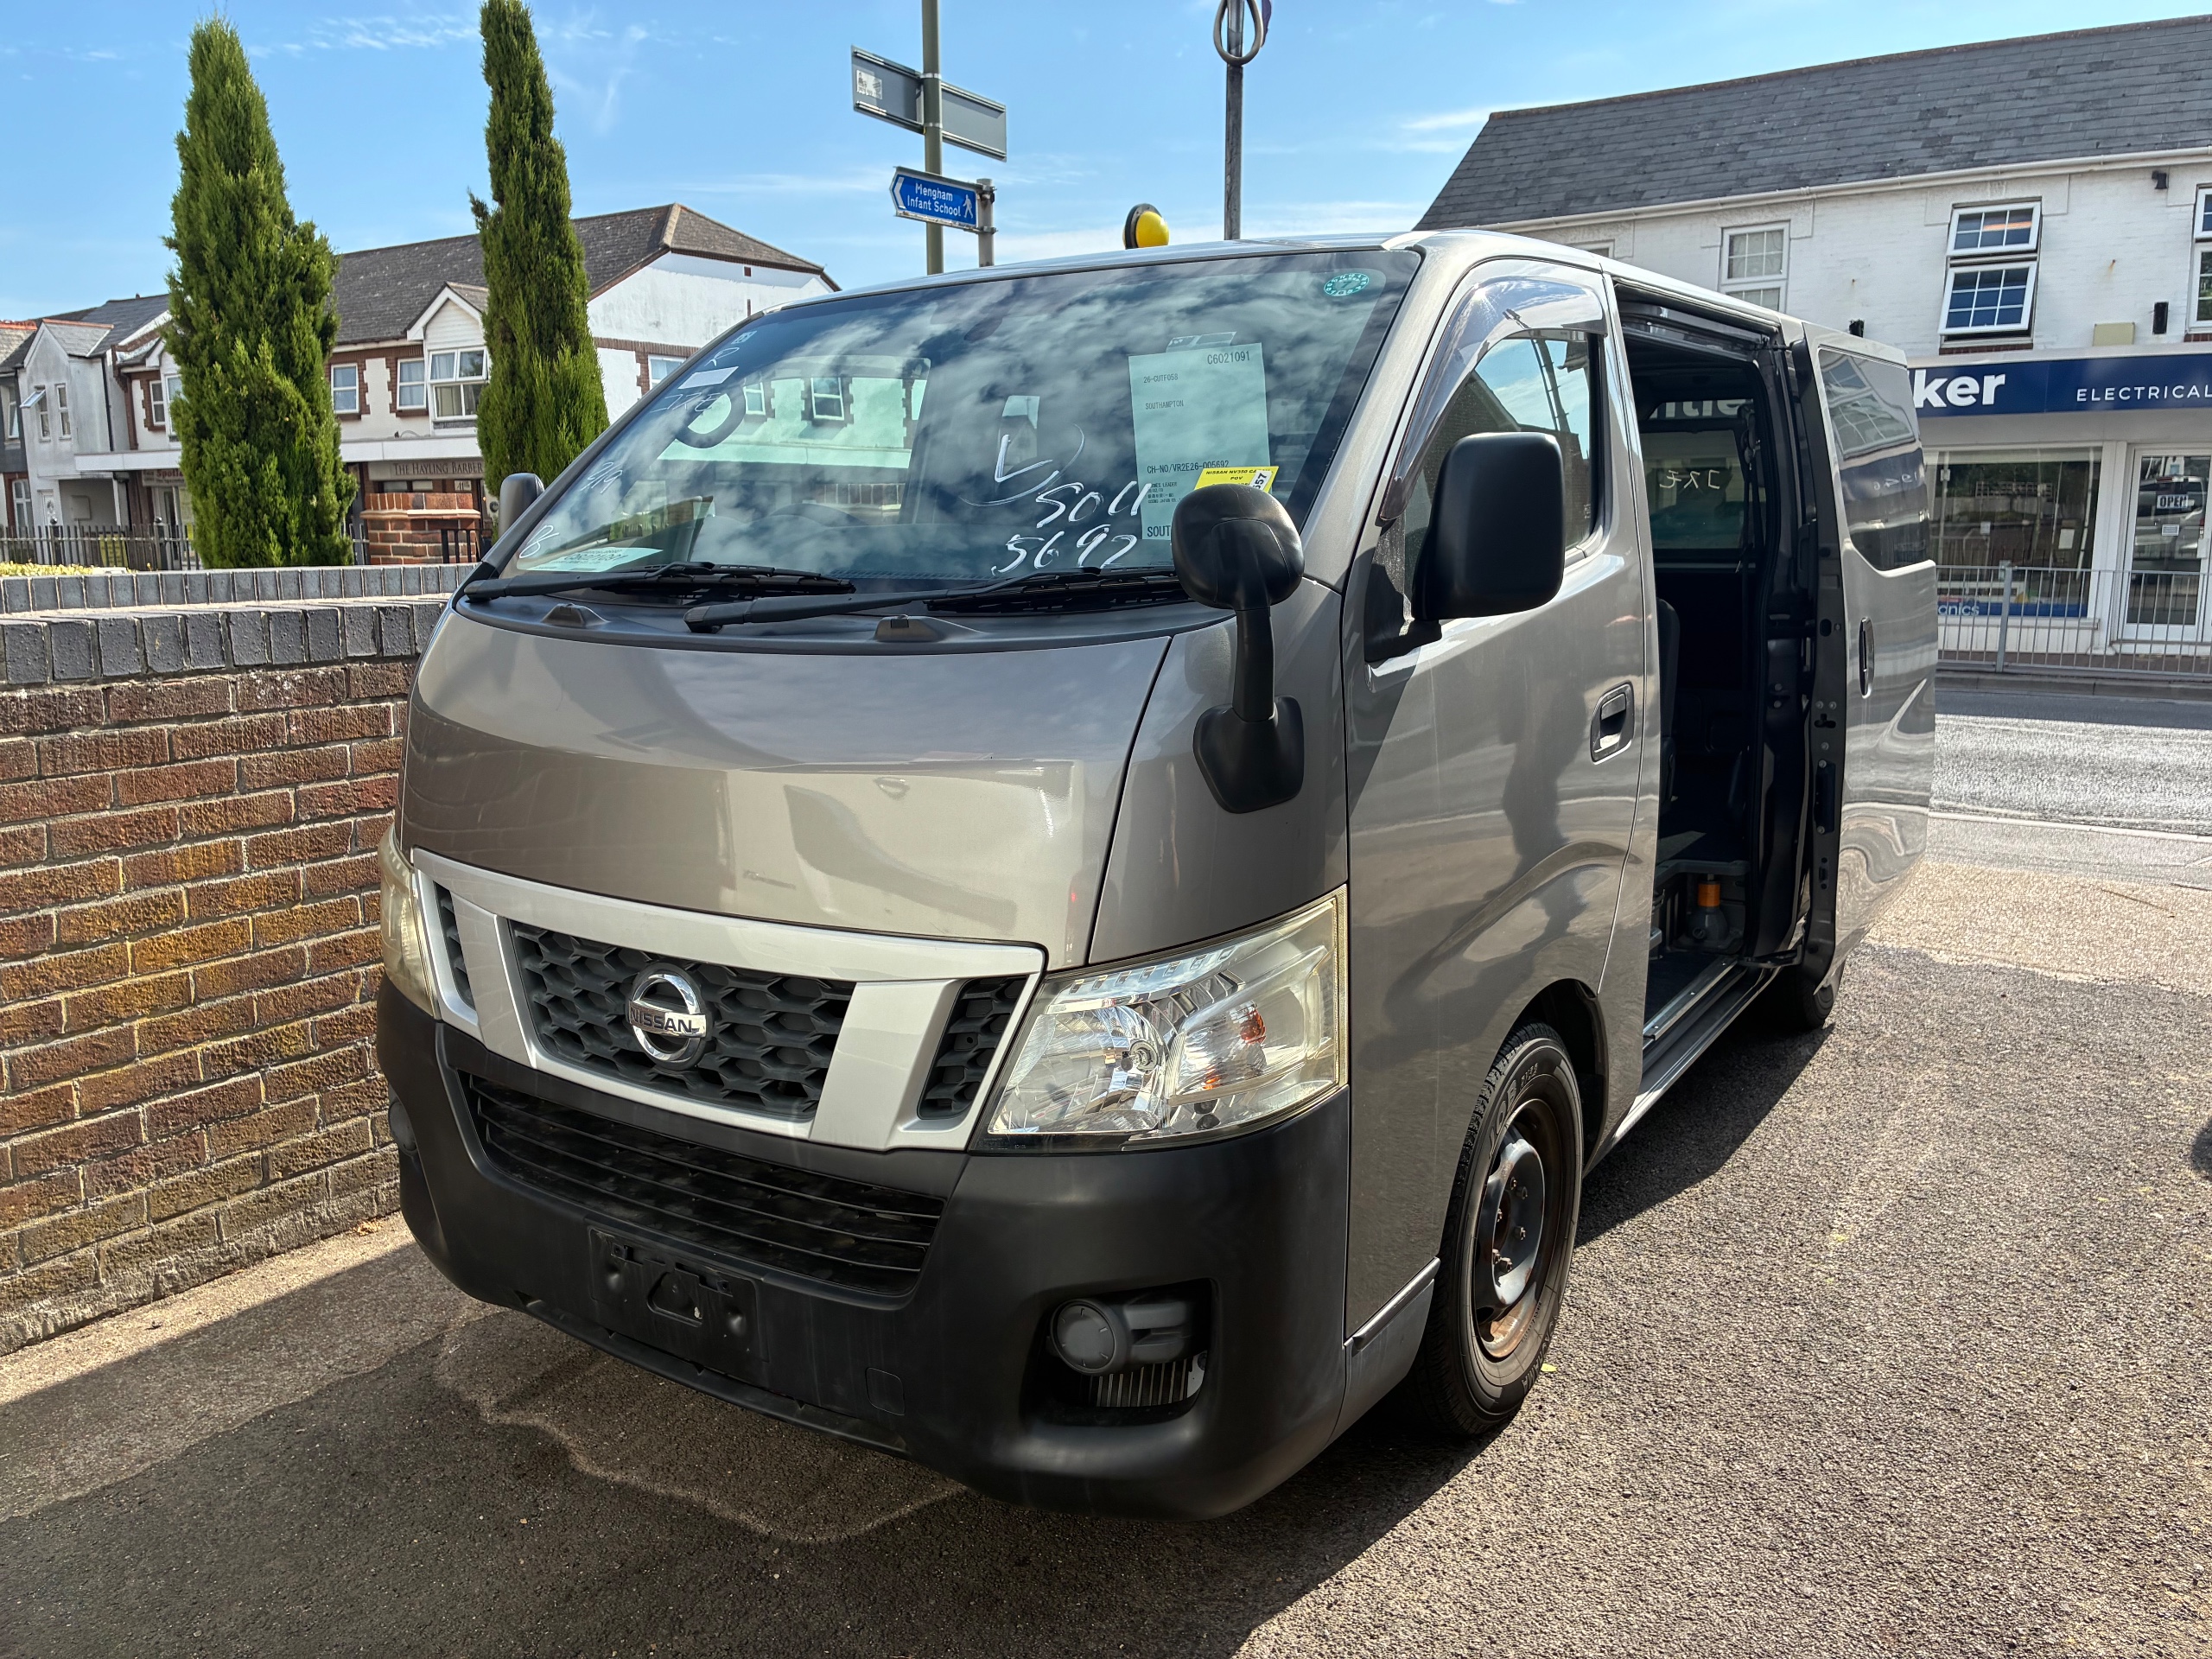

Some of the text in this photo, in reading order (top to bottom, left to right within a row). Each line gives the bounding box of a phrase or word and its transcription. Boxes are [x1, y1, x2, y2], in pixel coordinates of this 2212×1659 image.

[915, 182, 953, 201] Mengham
[907, 194, 961, 217] Infant School
[1207, 350, 1250, 365] C6021091
[1908, 369, 2005, 408] ker
[2076, 384, 2212, 403] ELECTRICAL
[1145, 400, 1184, 410] SOUTHAMPTON
[394, 461, 483, 475] THE HAYLING BARBER
[2160, 495, 2186, 507] OPEN
[991, 524, 1138, 575] 5692
[630, 1007, 692, 1033] NISSAN
